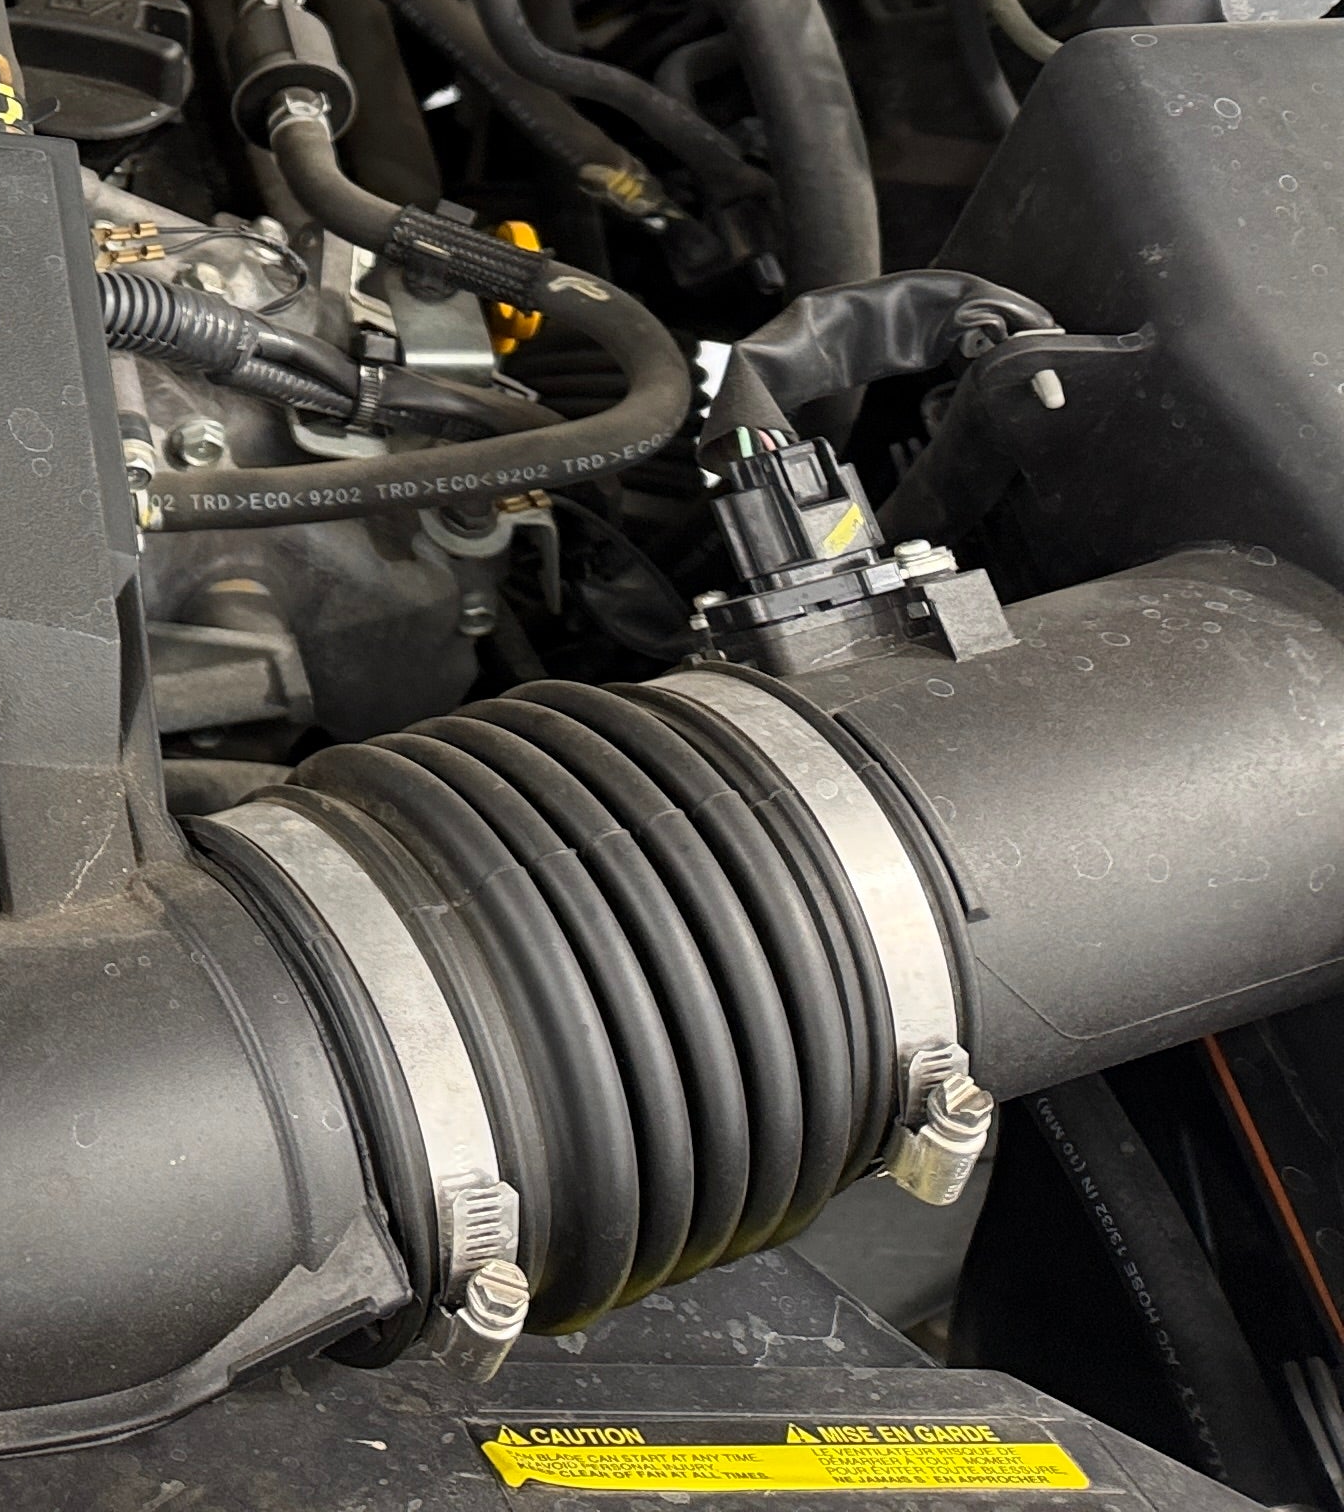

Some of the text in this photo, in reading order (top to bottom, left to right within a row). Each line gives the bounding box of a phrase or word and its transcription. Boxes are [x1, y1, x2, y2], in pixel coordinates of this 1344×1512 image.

[1123, 1260, 1160, 1324] HOSE
[529, 1426, 647, 1446] CAUTION
[817, 1424, 1002, 1443] MISE EN GARDE
[536, 1452, 584, 1463] BLADE
[587, 1453, 619, 1463] CAN
[622, 1453, 669, 1463] START
[671, 1453, 690, 1463] AT
[692, 1453, 721, 1463] ANY
[812, 1447, 1017, 1458] LE VENTILATEUR RISQUE DE
[917, 1456, 955, 1466] TOUT
[961, 1456, 1023, 1466] MOMENT
[612, 1471, 632, 1479] OF
[636, 1471, 667, 1479] FAN
[667, 1471, 687, 1479] AT
[691, 1471, 722, 1480] ALL
[825, 1465, 868, 1476] POUR
[927, 1465, 979, 1476] TOUTE
[857, 1475, 913, 1485] JAMAIS
[934, 1475, 958, 1485] EN
[956, 1474, 1051, 1485] APPROCHER
